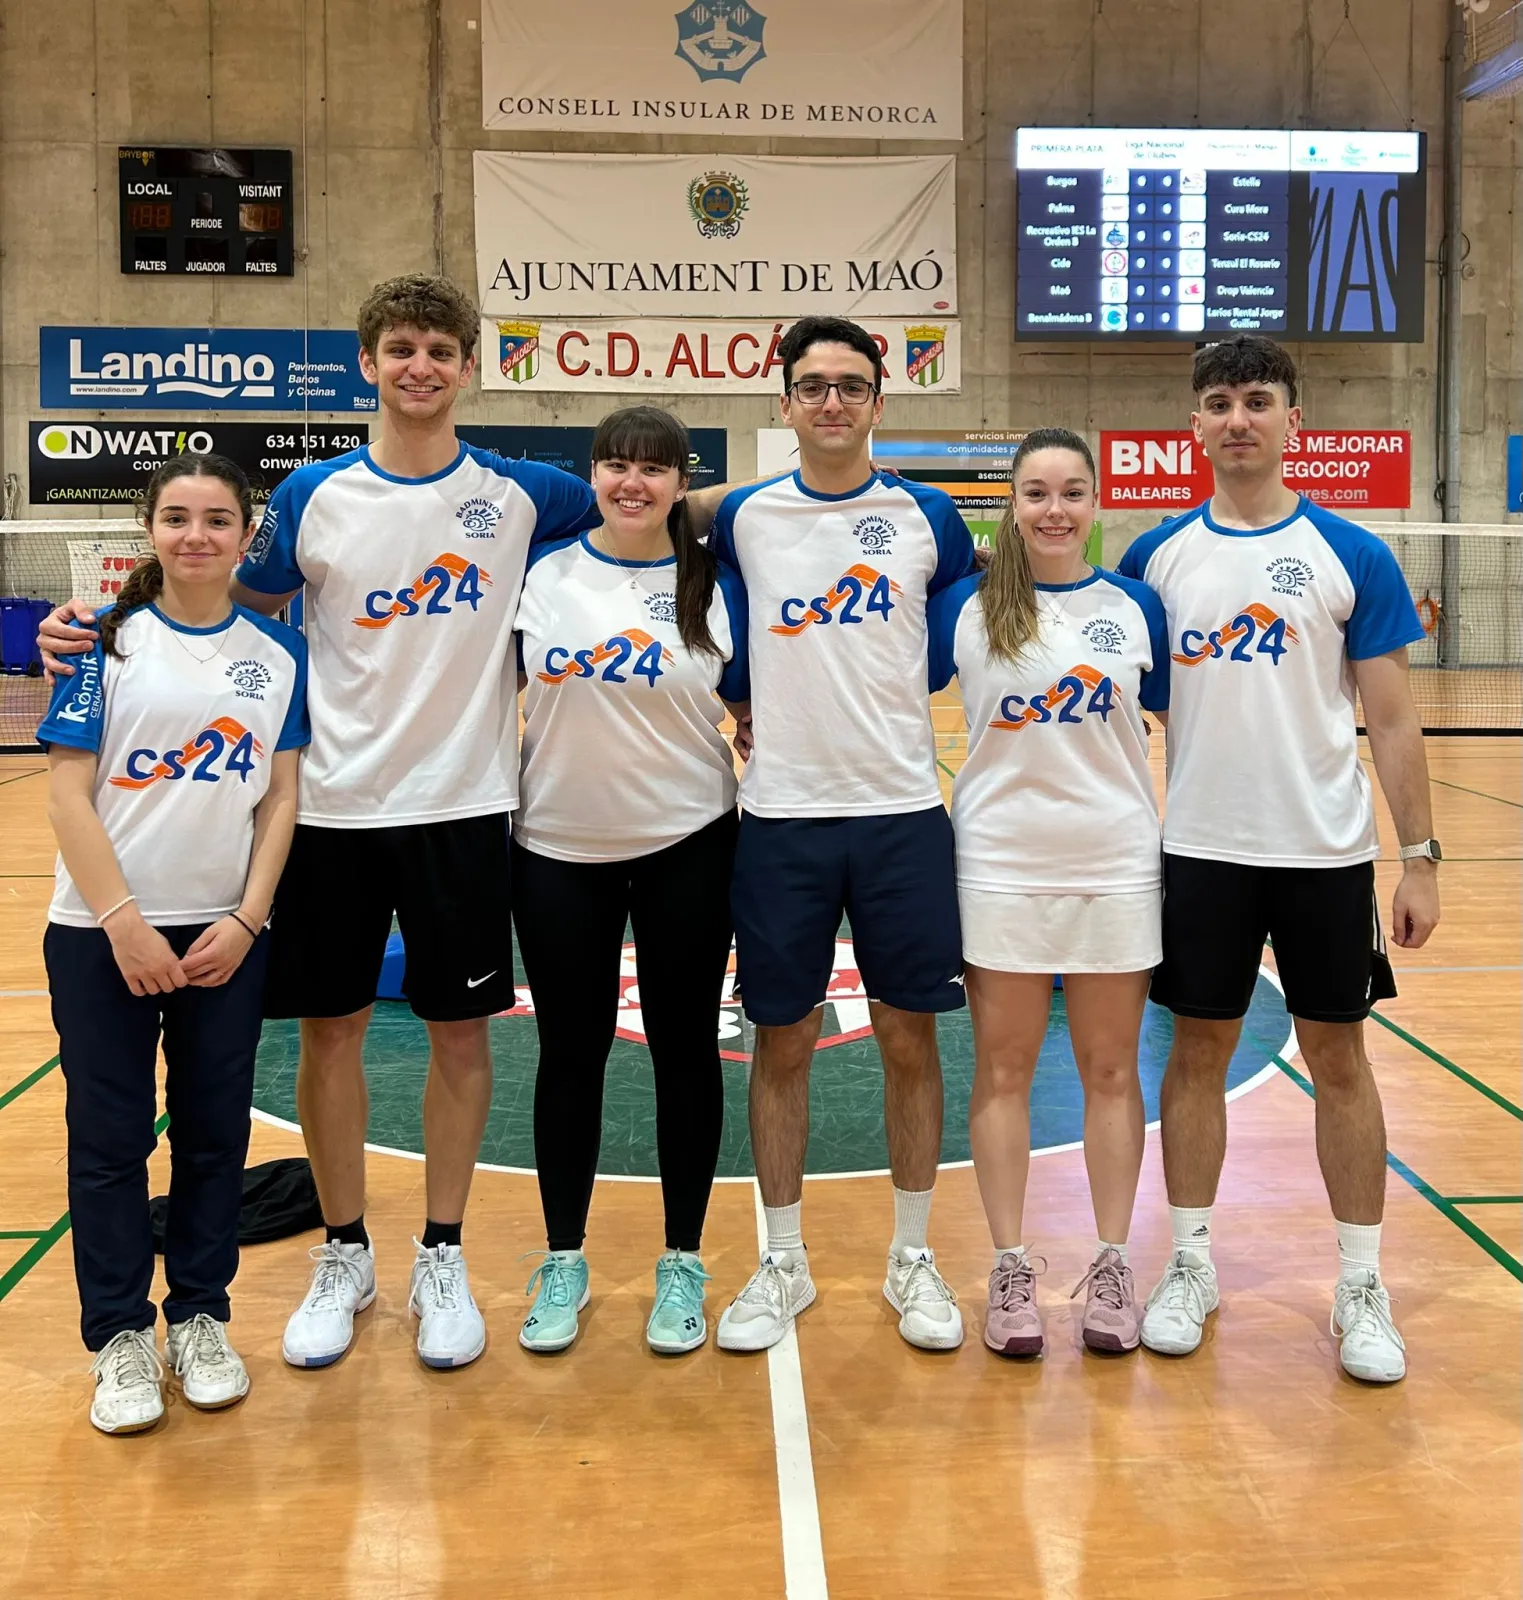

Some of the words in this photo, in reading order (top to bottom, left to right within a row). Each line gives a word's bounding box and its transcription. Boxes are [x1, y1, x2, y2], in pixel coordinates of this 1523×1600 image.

[499, 97, 621, 116] CONSELL
[632, 100, 751, 120] INSULAR
[761, 103, 795, 121] DE
[806, 105, 938, 124] MENORCA
[127, 183, 172, 195] LOCAL
[239, 185, 283, 198] VISITANT
[190, 218, 222, 229] PERIODE
[135, 261, 167, 271] FALTES
[185, 262, 226, 272] JUGADOR
[245, 262, 278, 272] FALTES
[489, 258, 770, 301] AJUNTAMENT
[780, 263, 833, 292] DE
[845, 249, 943, 292] MAÓ
[556, 330, 652, 377] C.D.
[665, 324, 891, 378] ALCÁR
[69, 338, 275, 383] Landino
[288, 362, 347, 373] Pavimentos,
[288, 375, 320, 384] Baños
[287, 389, 294, 398] y
[296, 387, 336, 397] Cocinas
[353, 396, 376, 404] Roca
[266, 435, 296, 449] 634
[299, 435, 326, 449] 151
[331, 435, 360, 449] 420
[965, 432, 1005, 440] servicios
[947, 443, 1008, 453] comunidades
[1306, 436, 1403, 453] MEJORAR
[1282, 461, 1370, 478] EGOCIO?
[46, 488, 144, 501] ¡GARANTIZAMOS
[1111, 487, 1192, 500] BALEARES
[455, 498, 503, 519] BADMINTON
[853, 515, 898, 537] BADMINTON
[1265, 556, 1315, 581] BADMINTON
[643, 591, 677, 606] BADMI
[1272, 586, 1303, 598] SORIA
[650, 615, 677, 624] SORI
[1081, 619, 1127, 641] BADMINTON
[1093, 647, 1122, 656] SORIA
[225, 660, 272, 683] BADMINTON
[235, 690, 265, 701] SORIA
